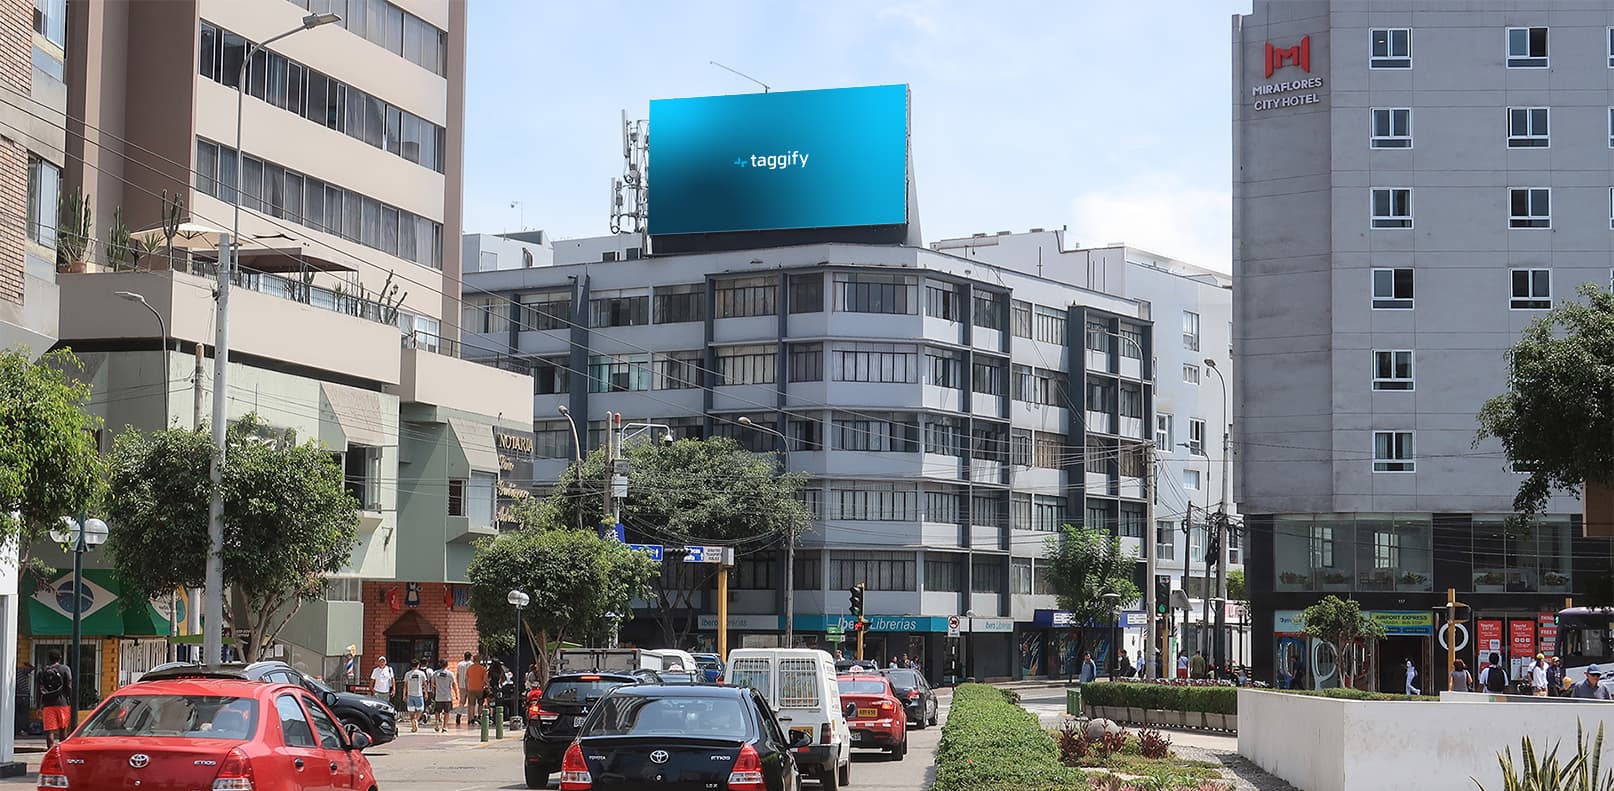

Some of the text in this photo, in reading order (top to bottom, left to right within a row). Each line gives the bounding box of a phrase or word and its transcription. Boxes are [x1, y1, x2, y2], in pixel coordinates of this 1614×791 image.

[1252, 77, 1322, 96] MIRAFLORES
[1254, 93, 1320, 111] CITY HOTEL
[750, 150, 809, 170] taggify
[499, 432, 534, 453] NOTARIA
